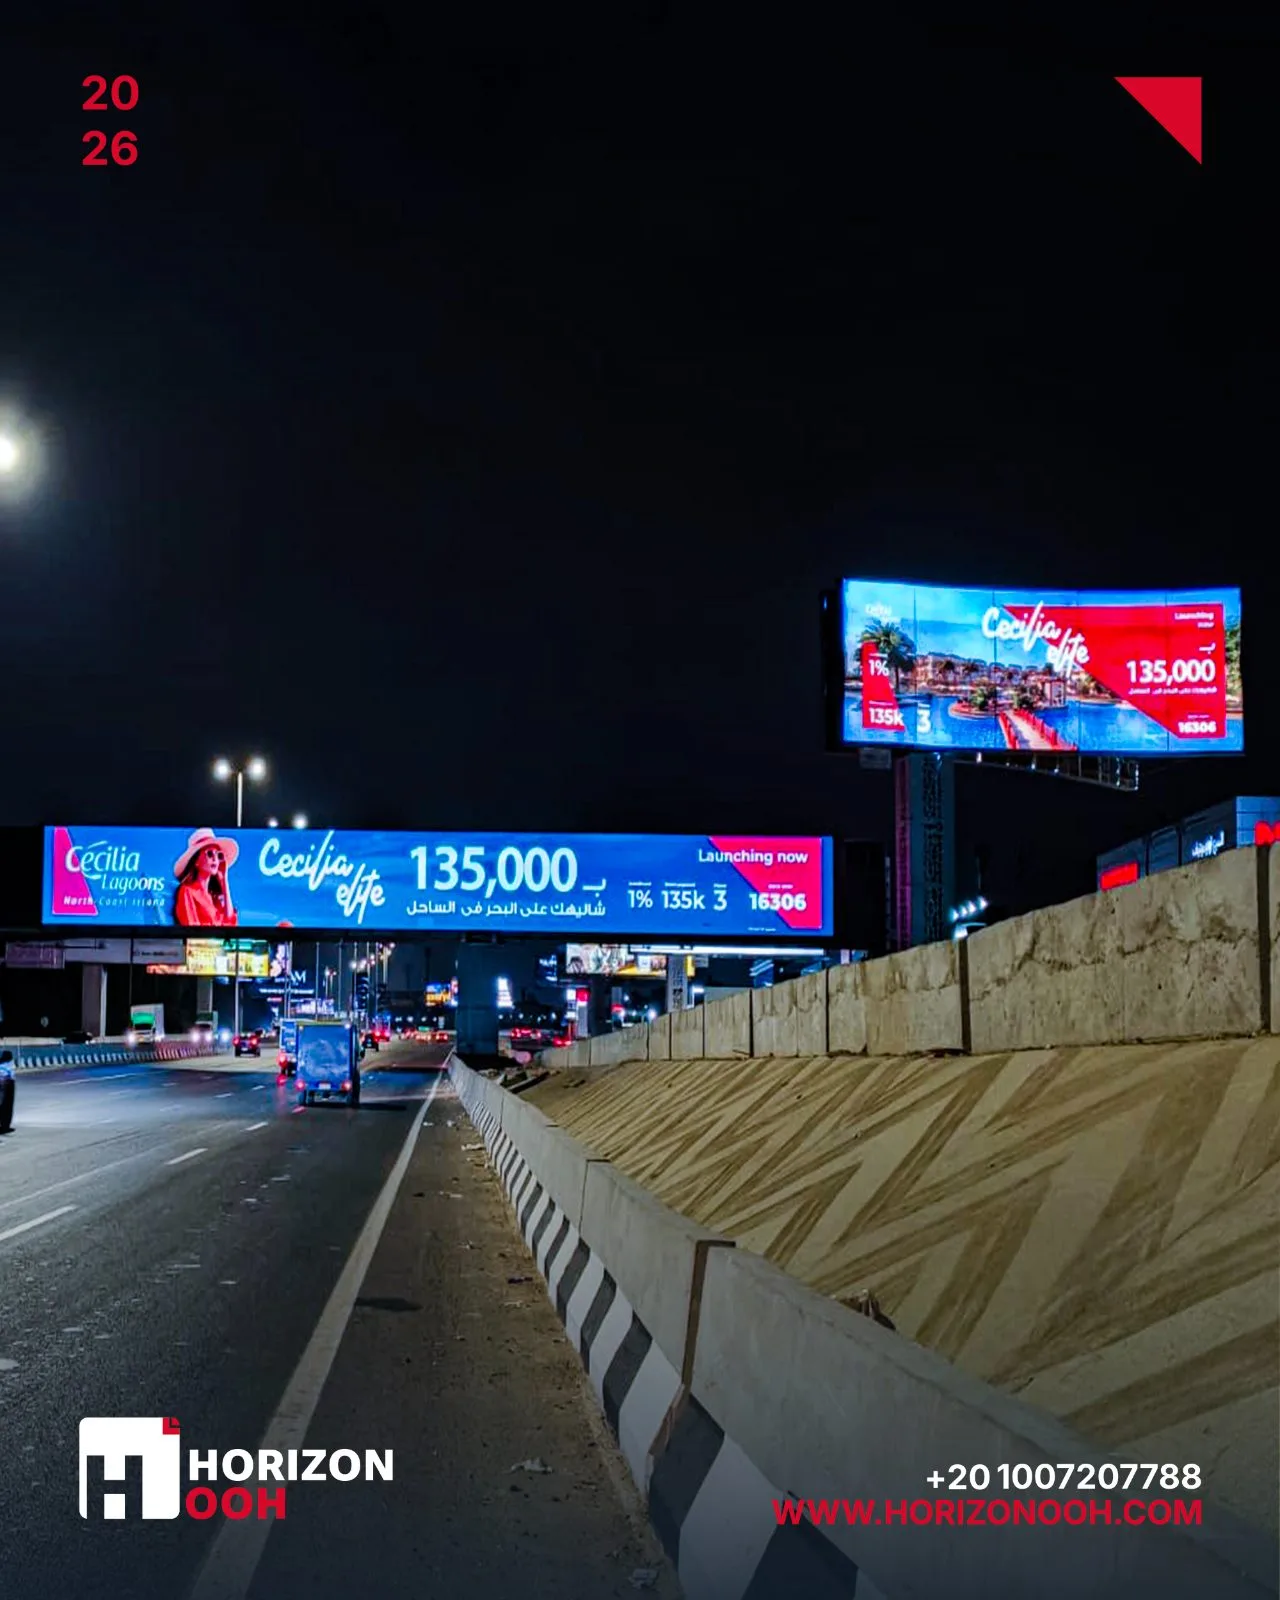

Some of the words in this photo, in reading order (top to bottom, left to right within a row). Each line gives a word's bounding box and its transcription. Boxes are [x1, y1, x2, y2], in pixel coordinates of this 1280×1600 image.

[982, 600, 1061, 652] Cecilia
[1046, 628, 1090, 679] elite
[868, 659, 890, 677] 1%
[1126, 658, 1217, 687] 135,000
[868, 706, 904, 727] 135k
[916, 708, 932, 734] 3
[259, 830, 354, 891] Cecilia
[698, 848, 774, 866] Launching
[777, 852, 809, 863] now
[410, 846, 578, 899] 135,000
[336, 863, 386, 925] elite
[628, 889, 653, 909] 1%
[661, 890, 705, 910] 135k
[713, 889, 728, 911] 3
[749, 892, 807, 911] 16306
[406, 900, 456, 916] الساحل
[520, 902, 548, 917] على
